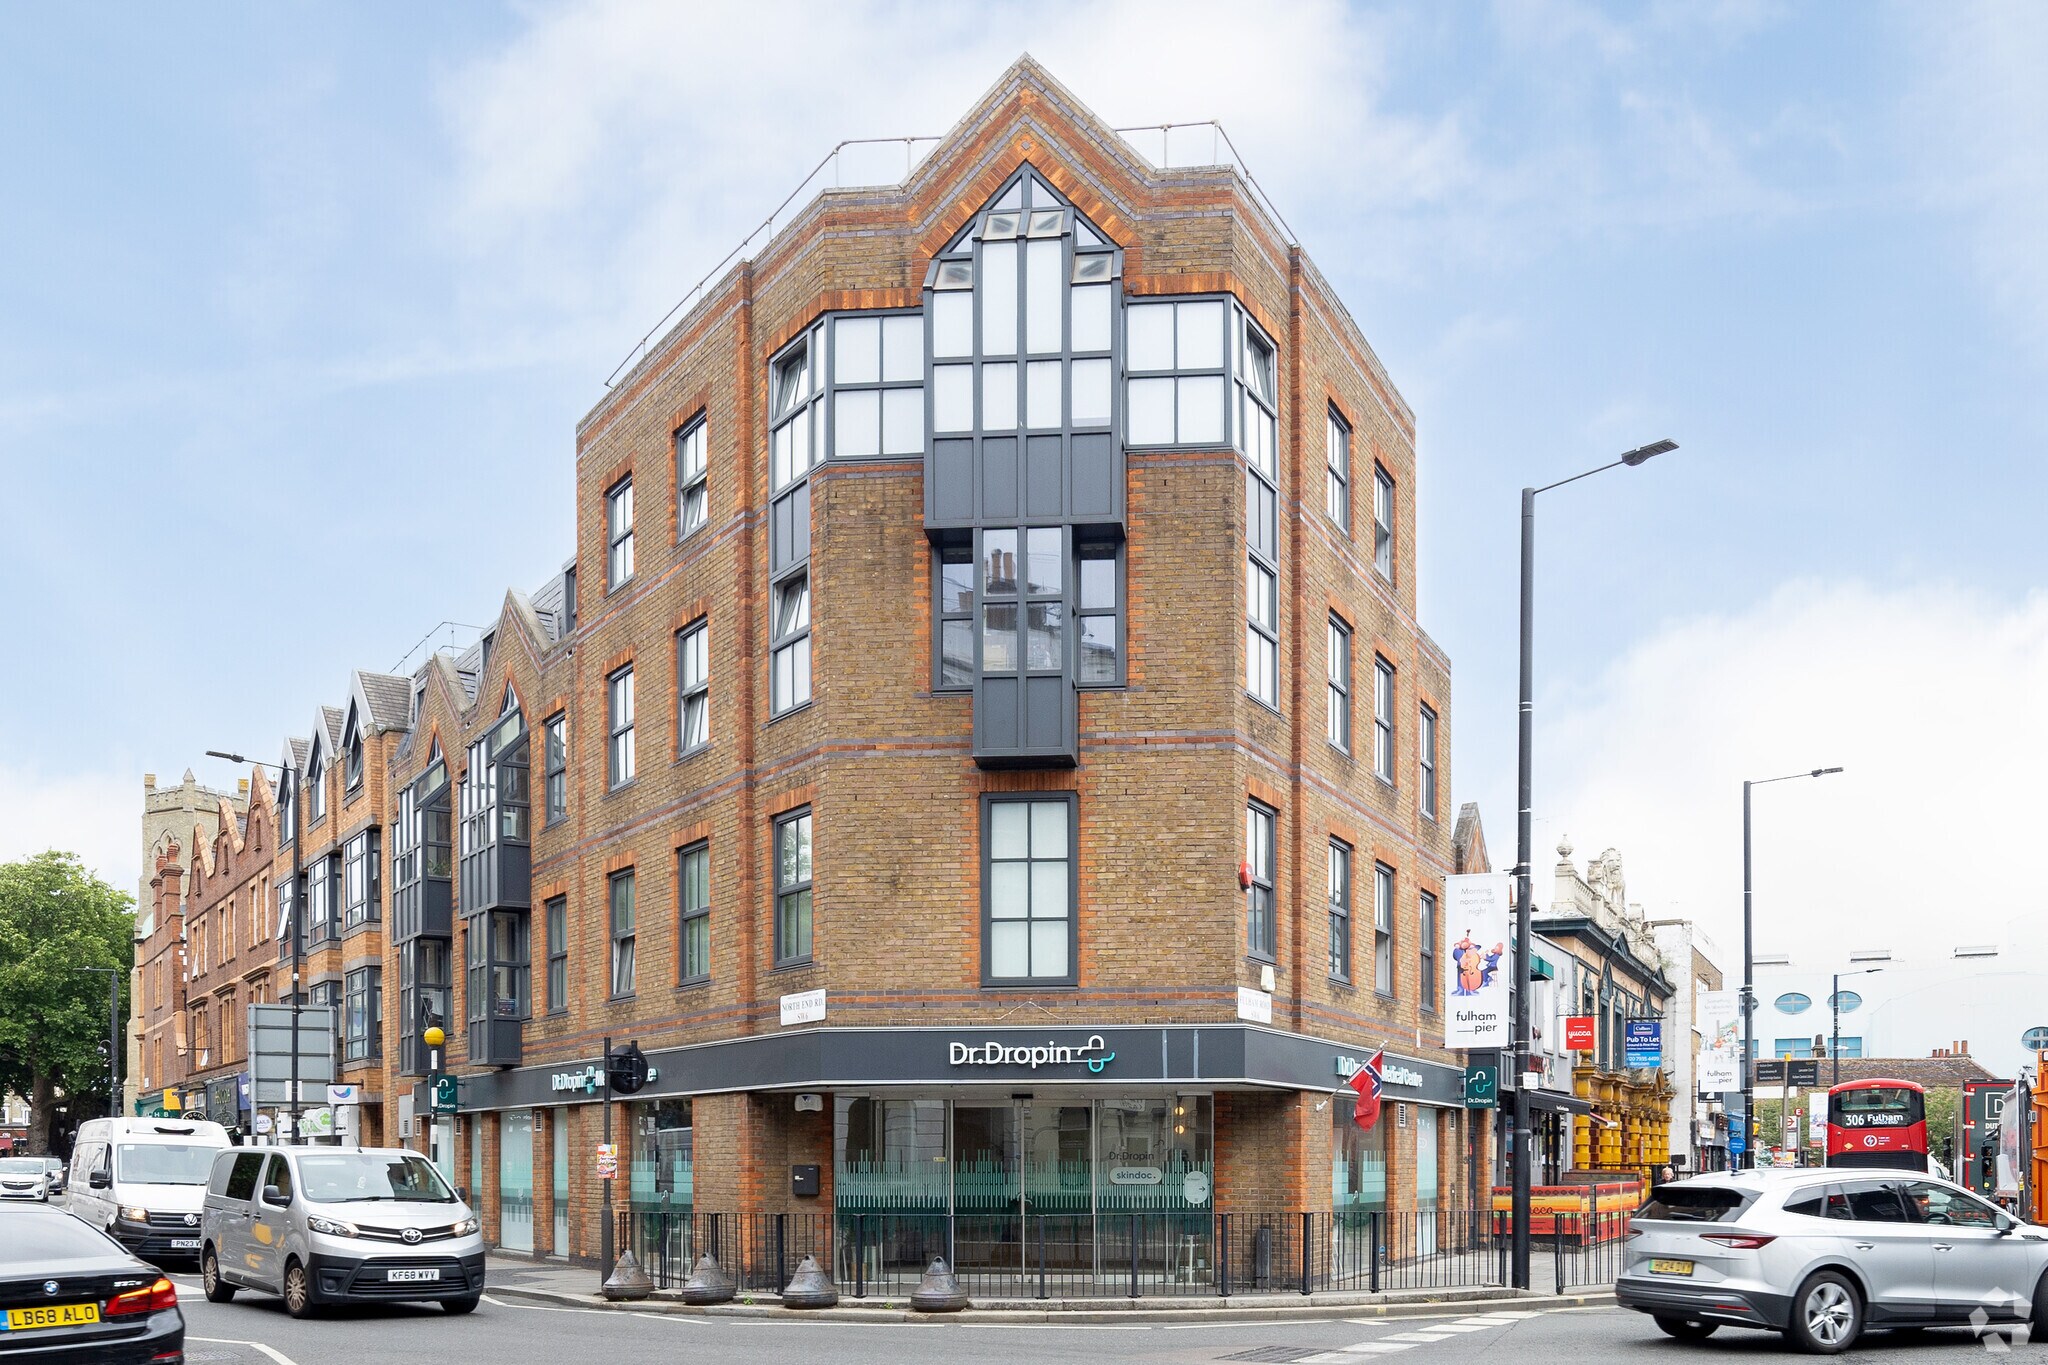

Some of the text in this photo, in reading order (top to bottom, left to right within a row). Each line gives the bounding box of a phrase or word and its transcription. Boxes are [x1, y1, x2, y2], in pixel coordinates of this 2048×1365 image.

[1468, 907, 1487, 917] night
[782, 1001, 801, 1012] NORTH
[801, 999, 814, 1010] END
[1456, 1010, 1497, 1022] fulham
[1567, 1030, 1592, 1040] yucca
[949, 1040, 1071, 1069] Dr.Dropin
[1467, 1097, 1493, 1105] Dr.Dropin
[1845, 1113, 1904, 1126] 306 Fulham
[1109, 1151, 1155, 1162] Dr.Dropin
[392, 1271, 416, 1280] KF68
[11, 1306, 95, 1327] LB68 ALO
